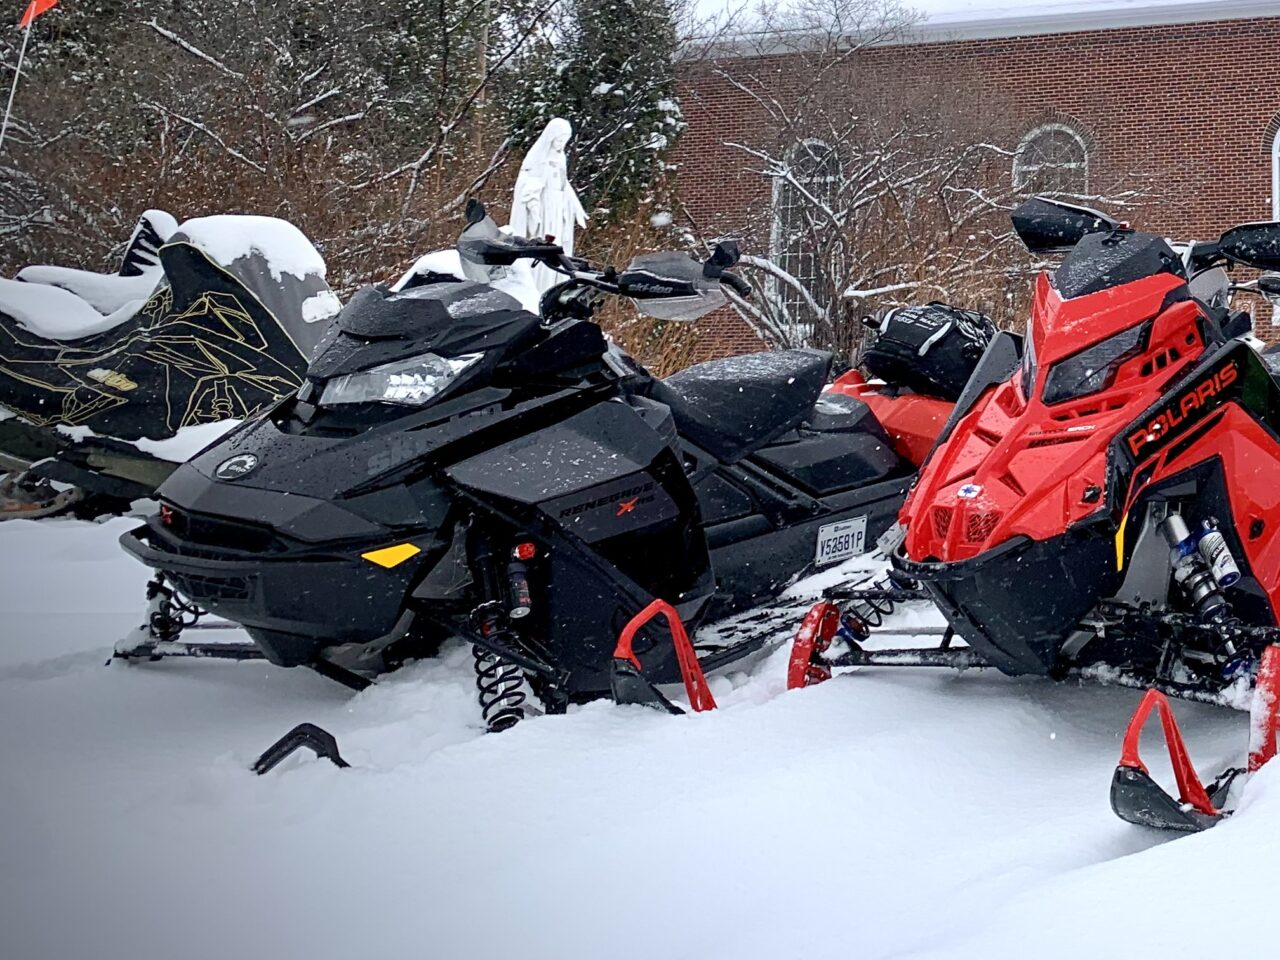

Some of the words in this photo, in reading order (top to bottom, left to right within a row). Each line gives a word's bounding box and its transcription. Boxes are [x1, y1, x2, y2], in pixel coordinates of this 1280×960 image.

[628, 282, 674, 294] ski-doo
[1128, 361, 1238, 457] POLARIS
[559, 481, 656, 519] RENEGADE
